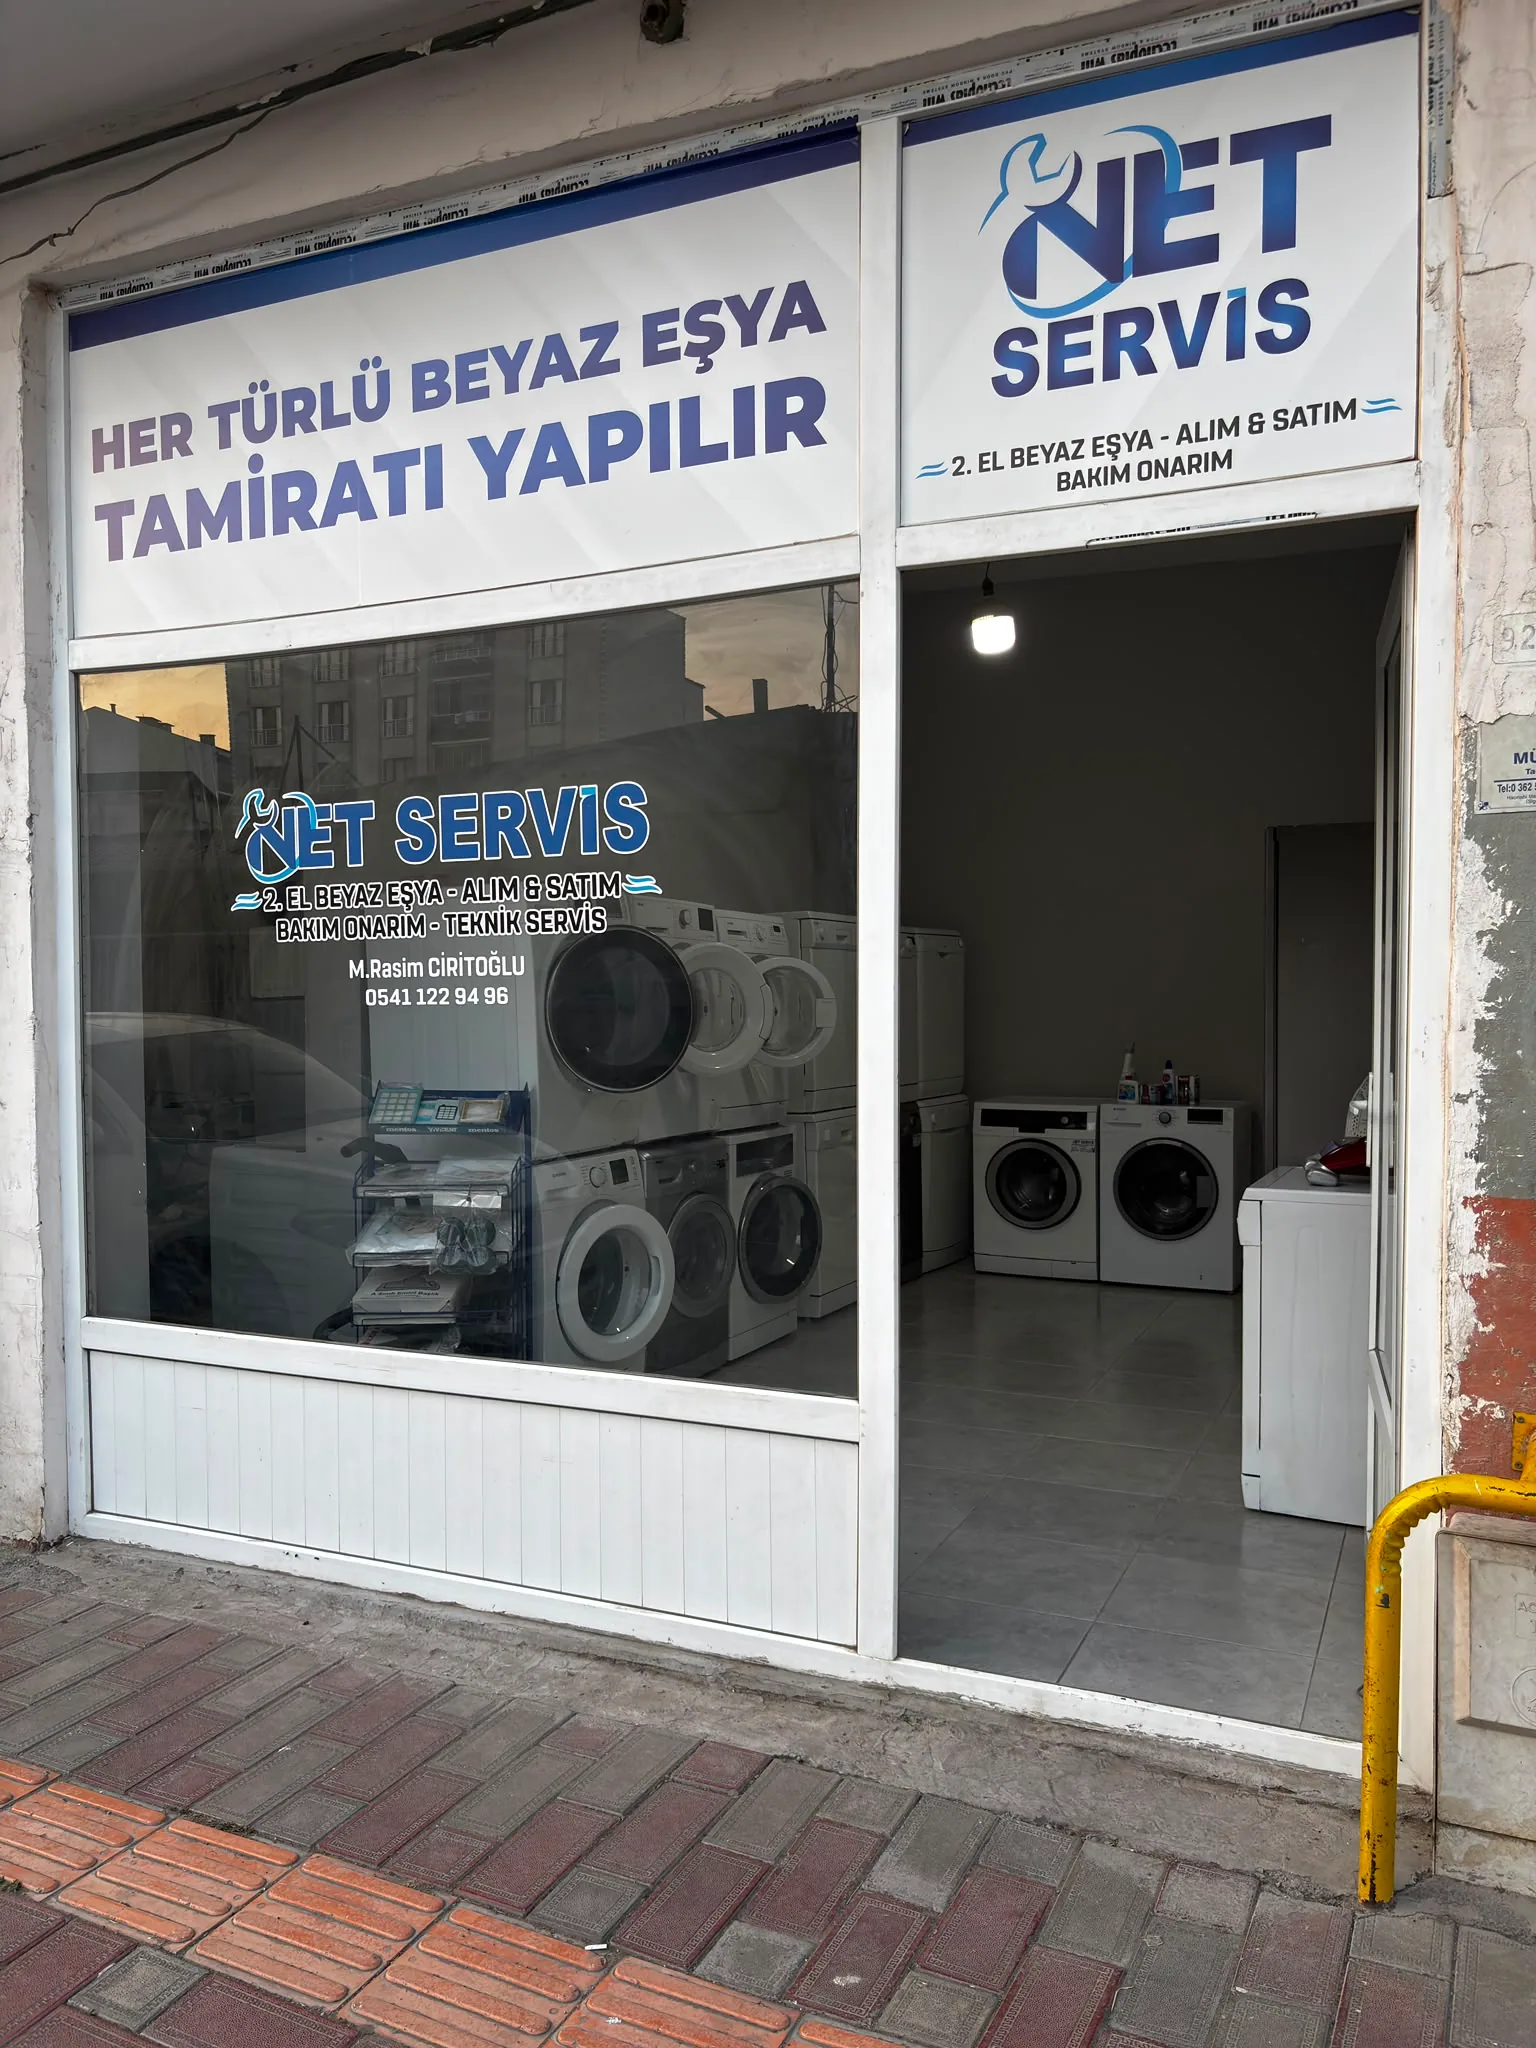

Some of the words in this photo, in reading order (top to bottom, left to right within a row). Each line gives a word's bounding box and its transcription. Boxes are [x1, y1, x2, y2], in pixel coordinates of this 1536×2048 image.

[991, 277, 1311, 398] SERVİS
[91, 411, 192, 474] HER
[207, 356, 392, 449] TÜRLÜ
[411, 320, 621, 413] BEYAZ
[642, 279, 826, 374] EŞYA
[951, 455, 973, 477] 2.
[977, 450, 1005, 474] EL
[1010, 439, 1086, 471] BEYAZ
[1091, 431, 1154, 466] EŞYA
[1175, 416, 1242, 446] ALIM
[1247, 412, 1266, 435] &
[1272, 399, 1358, 431] SATIM
[94, 442, 444, 562] TAMİRATI
[467, 375, 828, 500] YAPILIR
[1055, 461, 1132, 493] BAKIM
[1136, 449, 1234, 482] ONARIM
[1518, 782, 1532, 791] 362
[245, 797, 376, 884] NET
[394, 780, 651, 866] SERVİS
[262, 887, 284, 913] 2.
[285, 884, 315, 911] EL
[317, 882, 383, 910] BEYAZ
[387, 879, 445, 914] EŞYA
[447, 886, 459, 898] -
[460, 875, 520, 904] ALIM
[525, 876, 542, 900] &
[545, 871, 623, 901] SATIM
[275, 913, 342, 943] BAKIM
[344, 910, 427, 940] ONARIM
[429, 921, 440, 932] -
[442, 903, 522, 938] TEKNİK
[525, 899, 607, 935] SERVİS
[348, 957, 424, 980] M.Rasim
[427, 950, 526, 978] CİRİTOĞLU
[365, 988, 413, 1007] 0541
[416, 987, 450, 1006] 122
[454, 987, 480, 1005] 94
[482, 986, 509, 1005] 96
